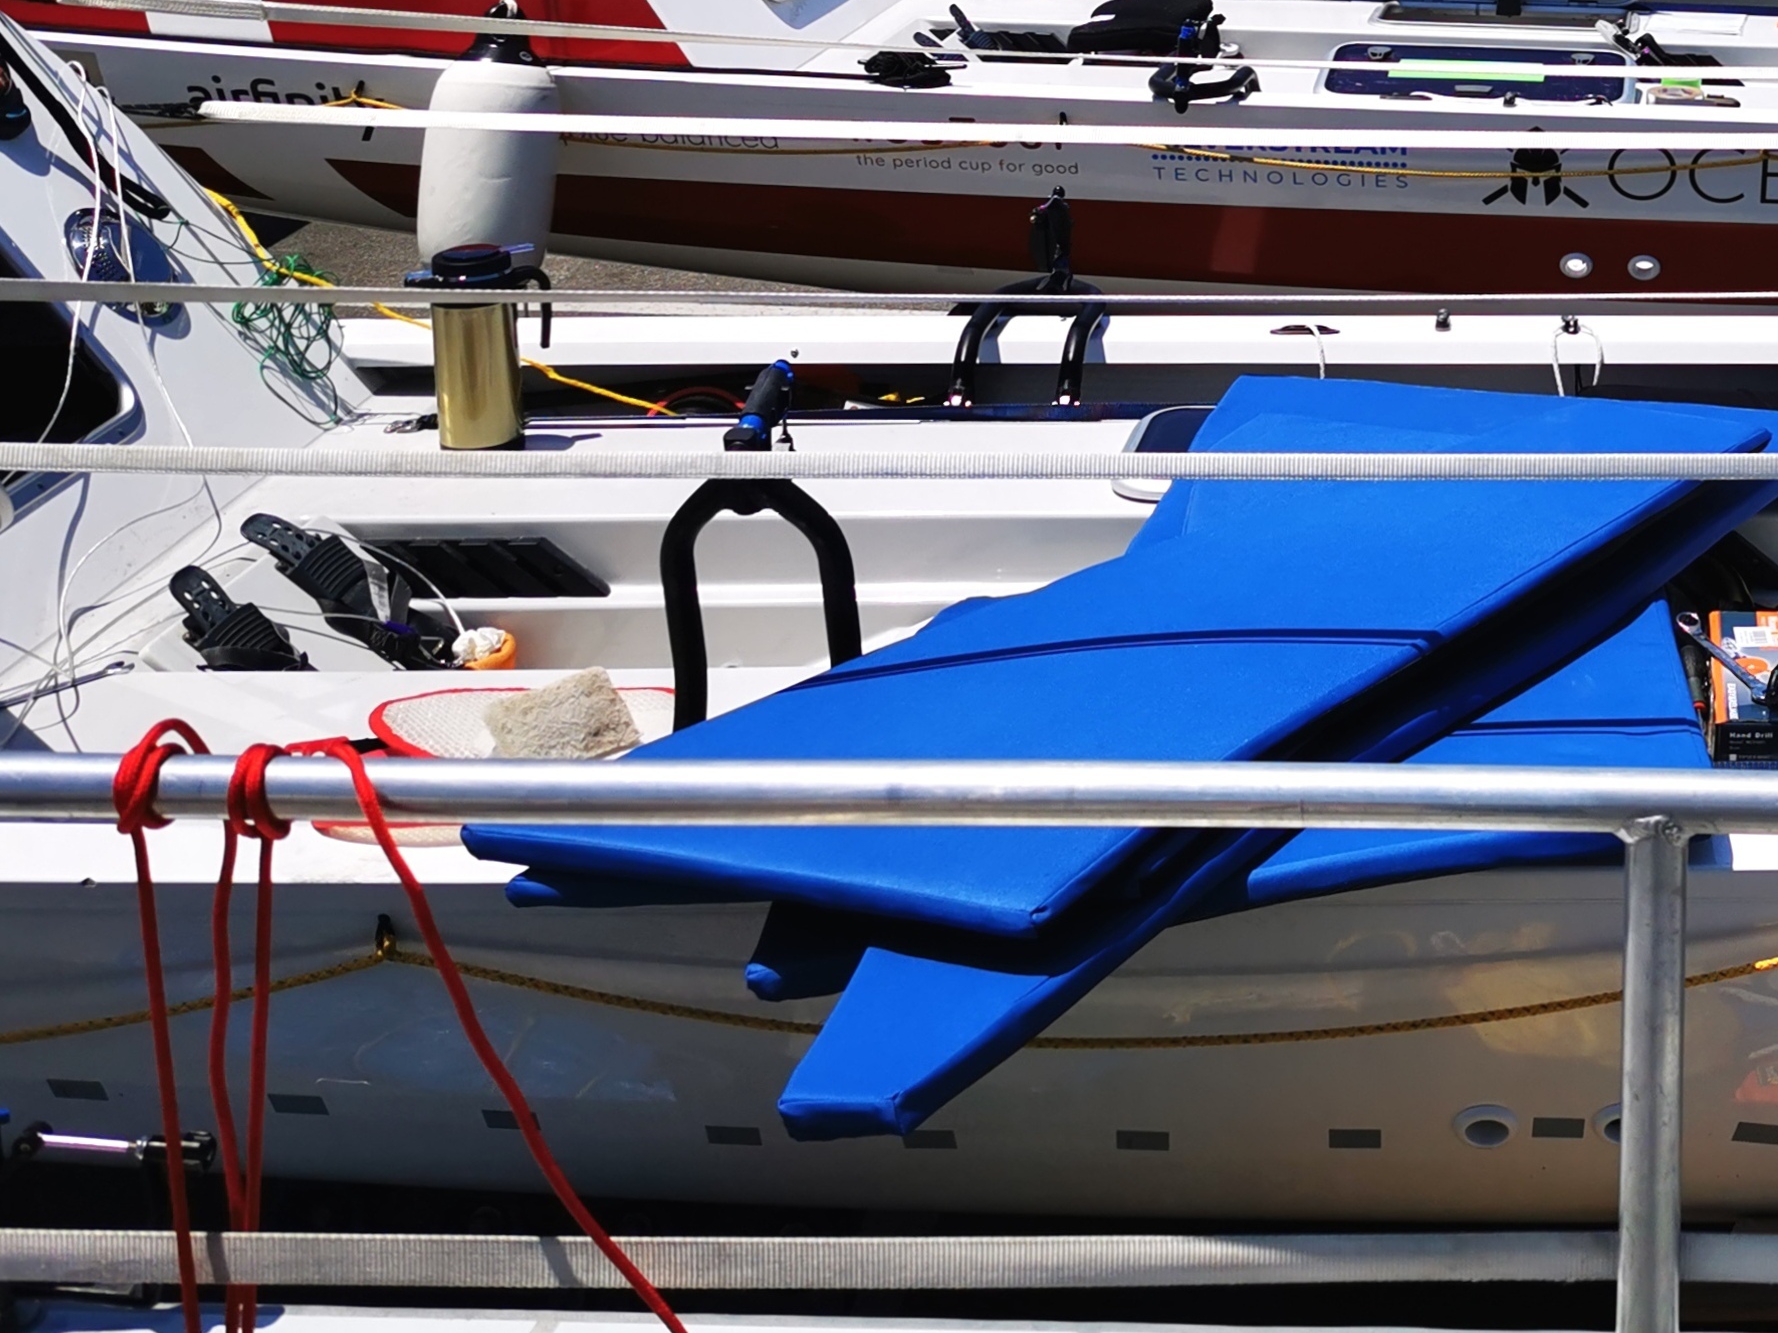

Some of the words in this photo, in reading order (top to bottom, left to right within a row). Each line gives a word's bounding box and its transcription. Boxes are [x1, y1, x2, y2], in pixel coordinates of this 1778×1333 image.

[856, 154, 886, 167] the
[893, 156, 951, 170] period
[958, 159, 992, 174] cup
[999, 159, 1026, 173] for
[1032, 162, 1079, 177] good
[1153, 166, 1409, 189] TECHNOLOGIES
[1754, 731, 1774, 739] Drill
